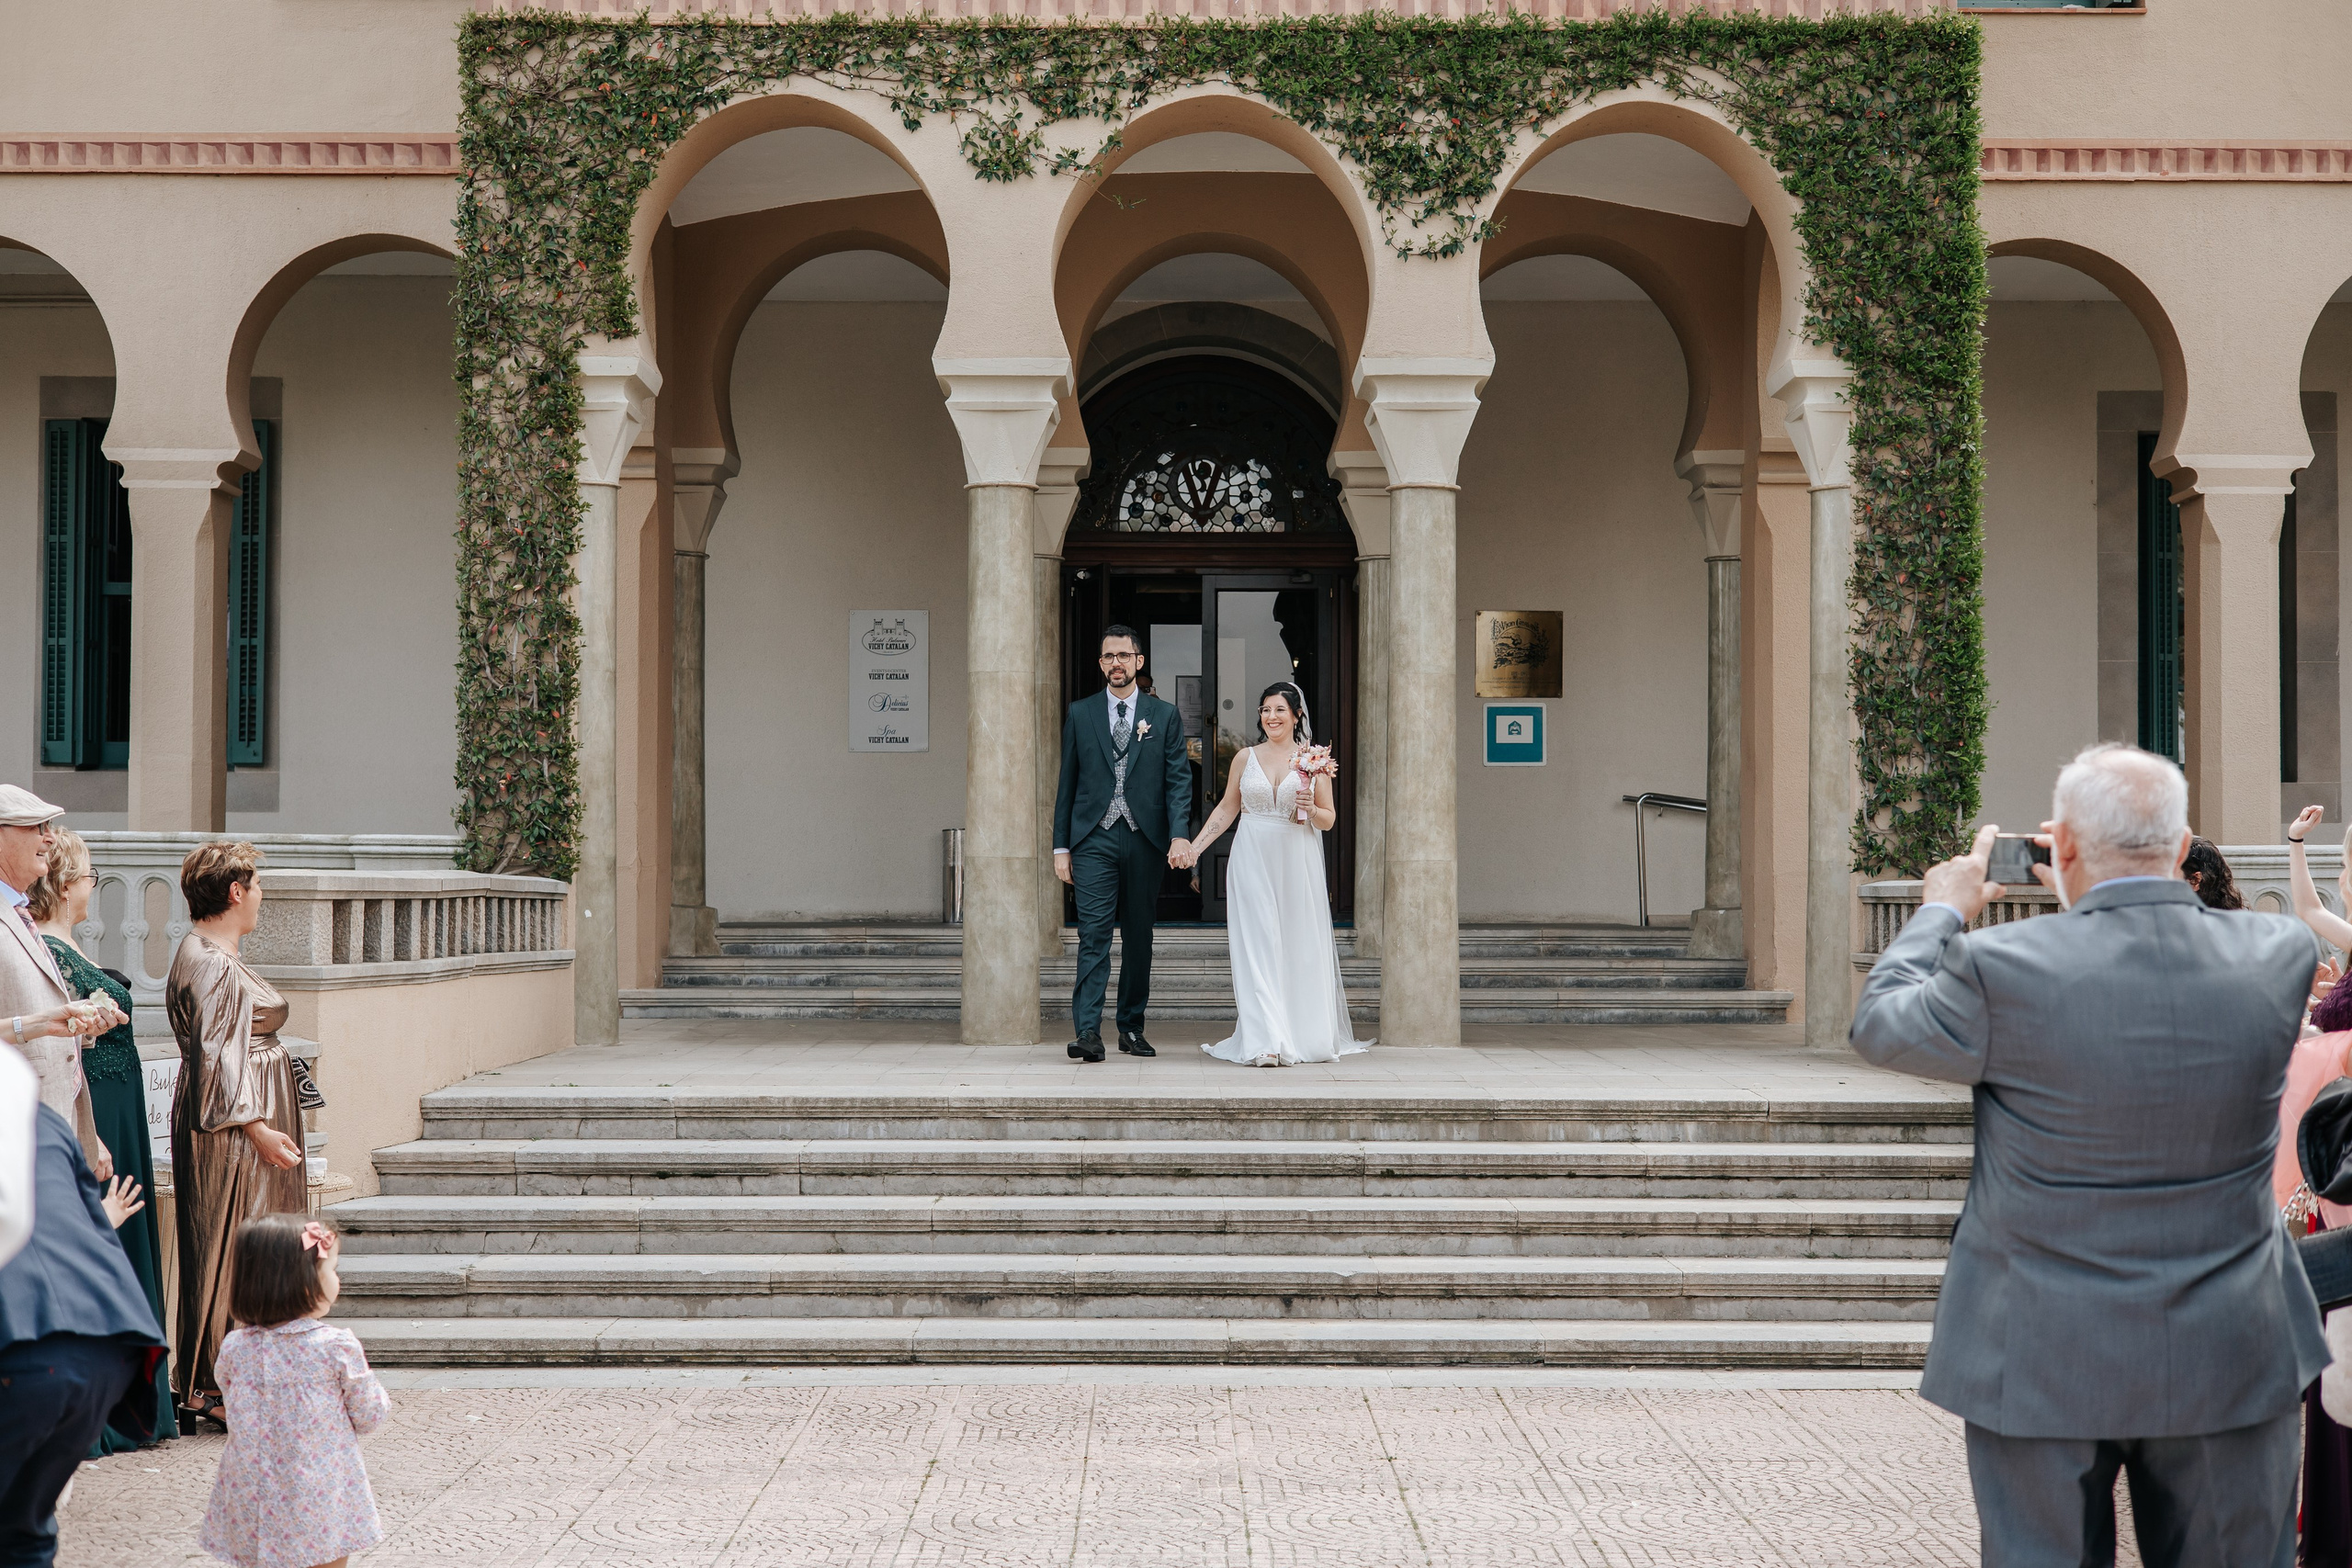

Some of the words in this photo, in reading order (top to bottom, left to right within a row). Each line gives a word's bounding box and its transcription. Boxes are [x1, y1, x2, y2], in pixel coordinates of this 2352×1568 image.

[876, 725, 897, 737] Spa
[150, 1066, 178, 1098] Bufe
[147, 1103, 164, 1125] de
